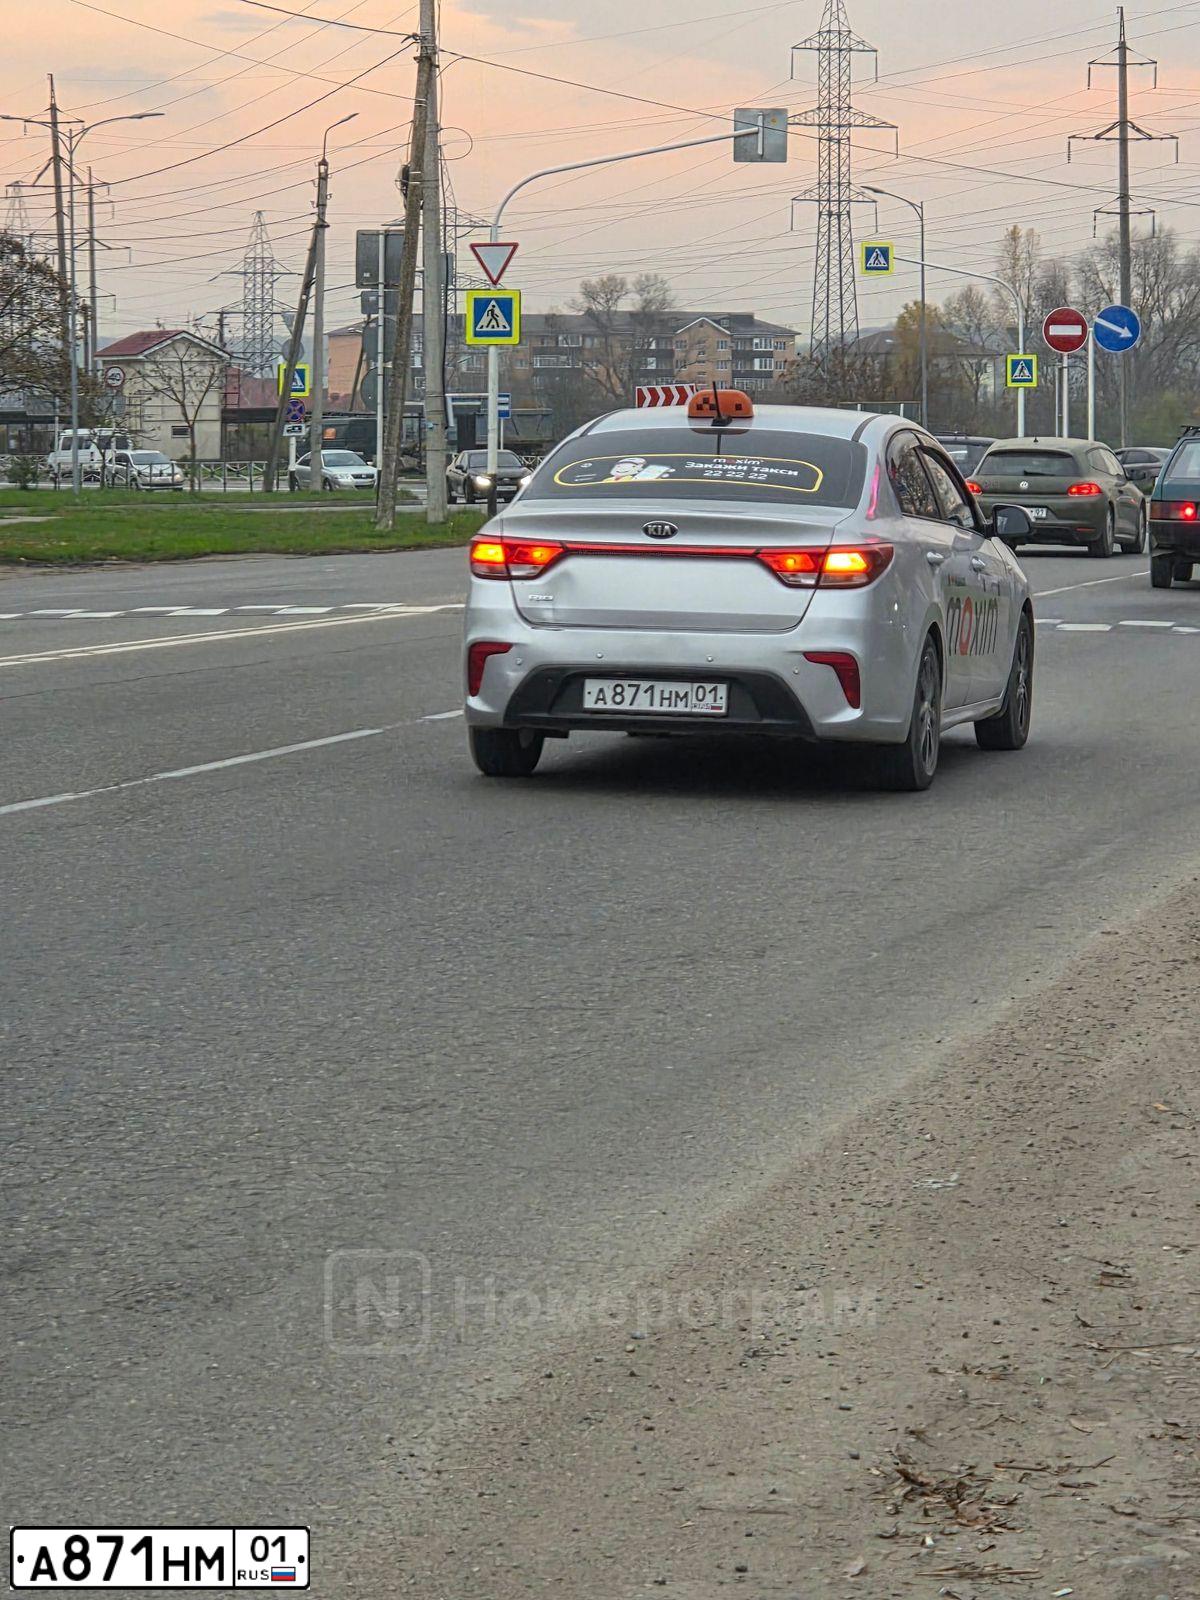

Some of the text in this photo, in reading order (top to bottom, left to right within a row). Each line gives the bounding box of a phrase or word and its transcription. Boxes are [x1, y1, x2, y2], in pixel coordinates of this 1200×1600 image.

[684, 461, 799, 476] Закажи такси
[703, 469, 768, 480] 22 22 22
[647, 524, 672, 536] KIA
[695, 685, 718, 703] 01
